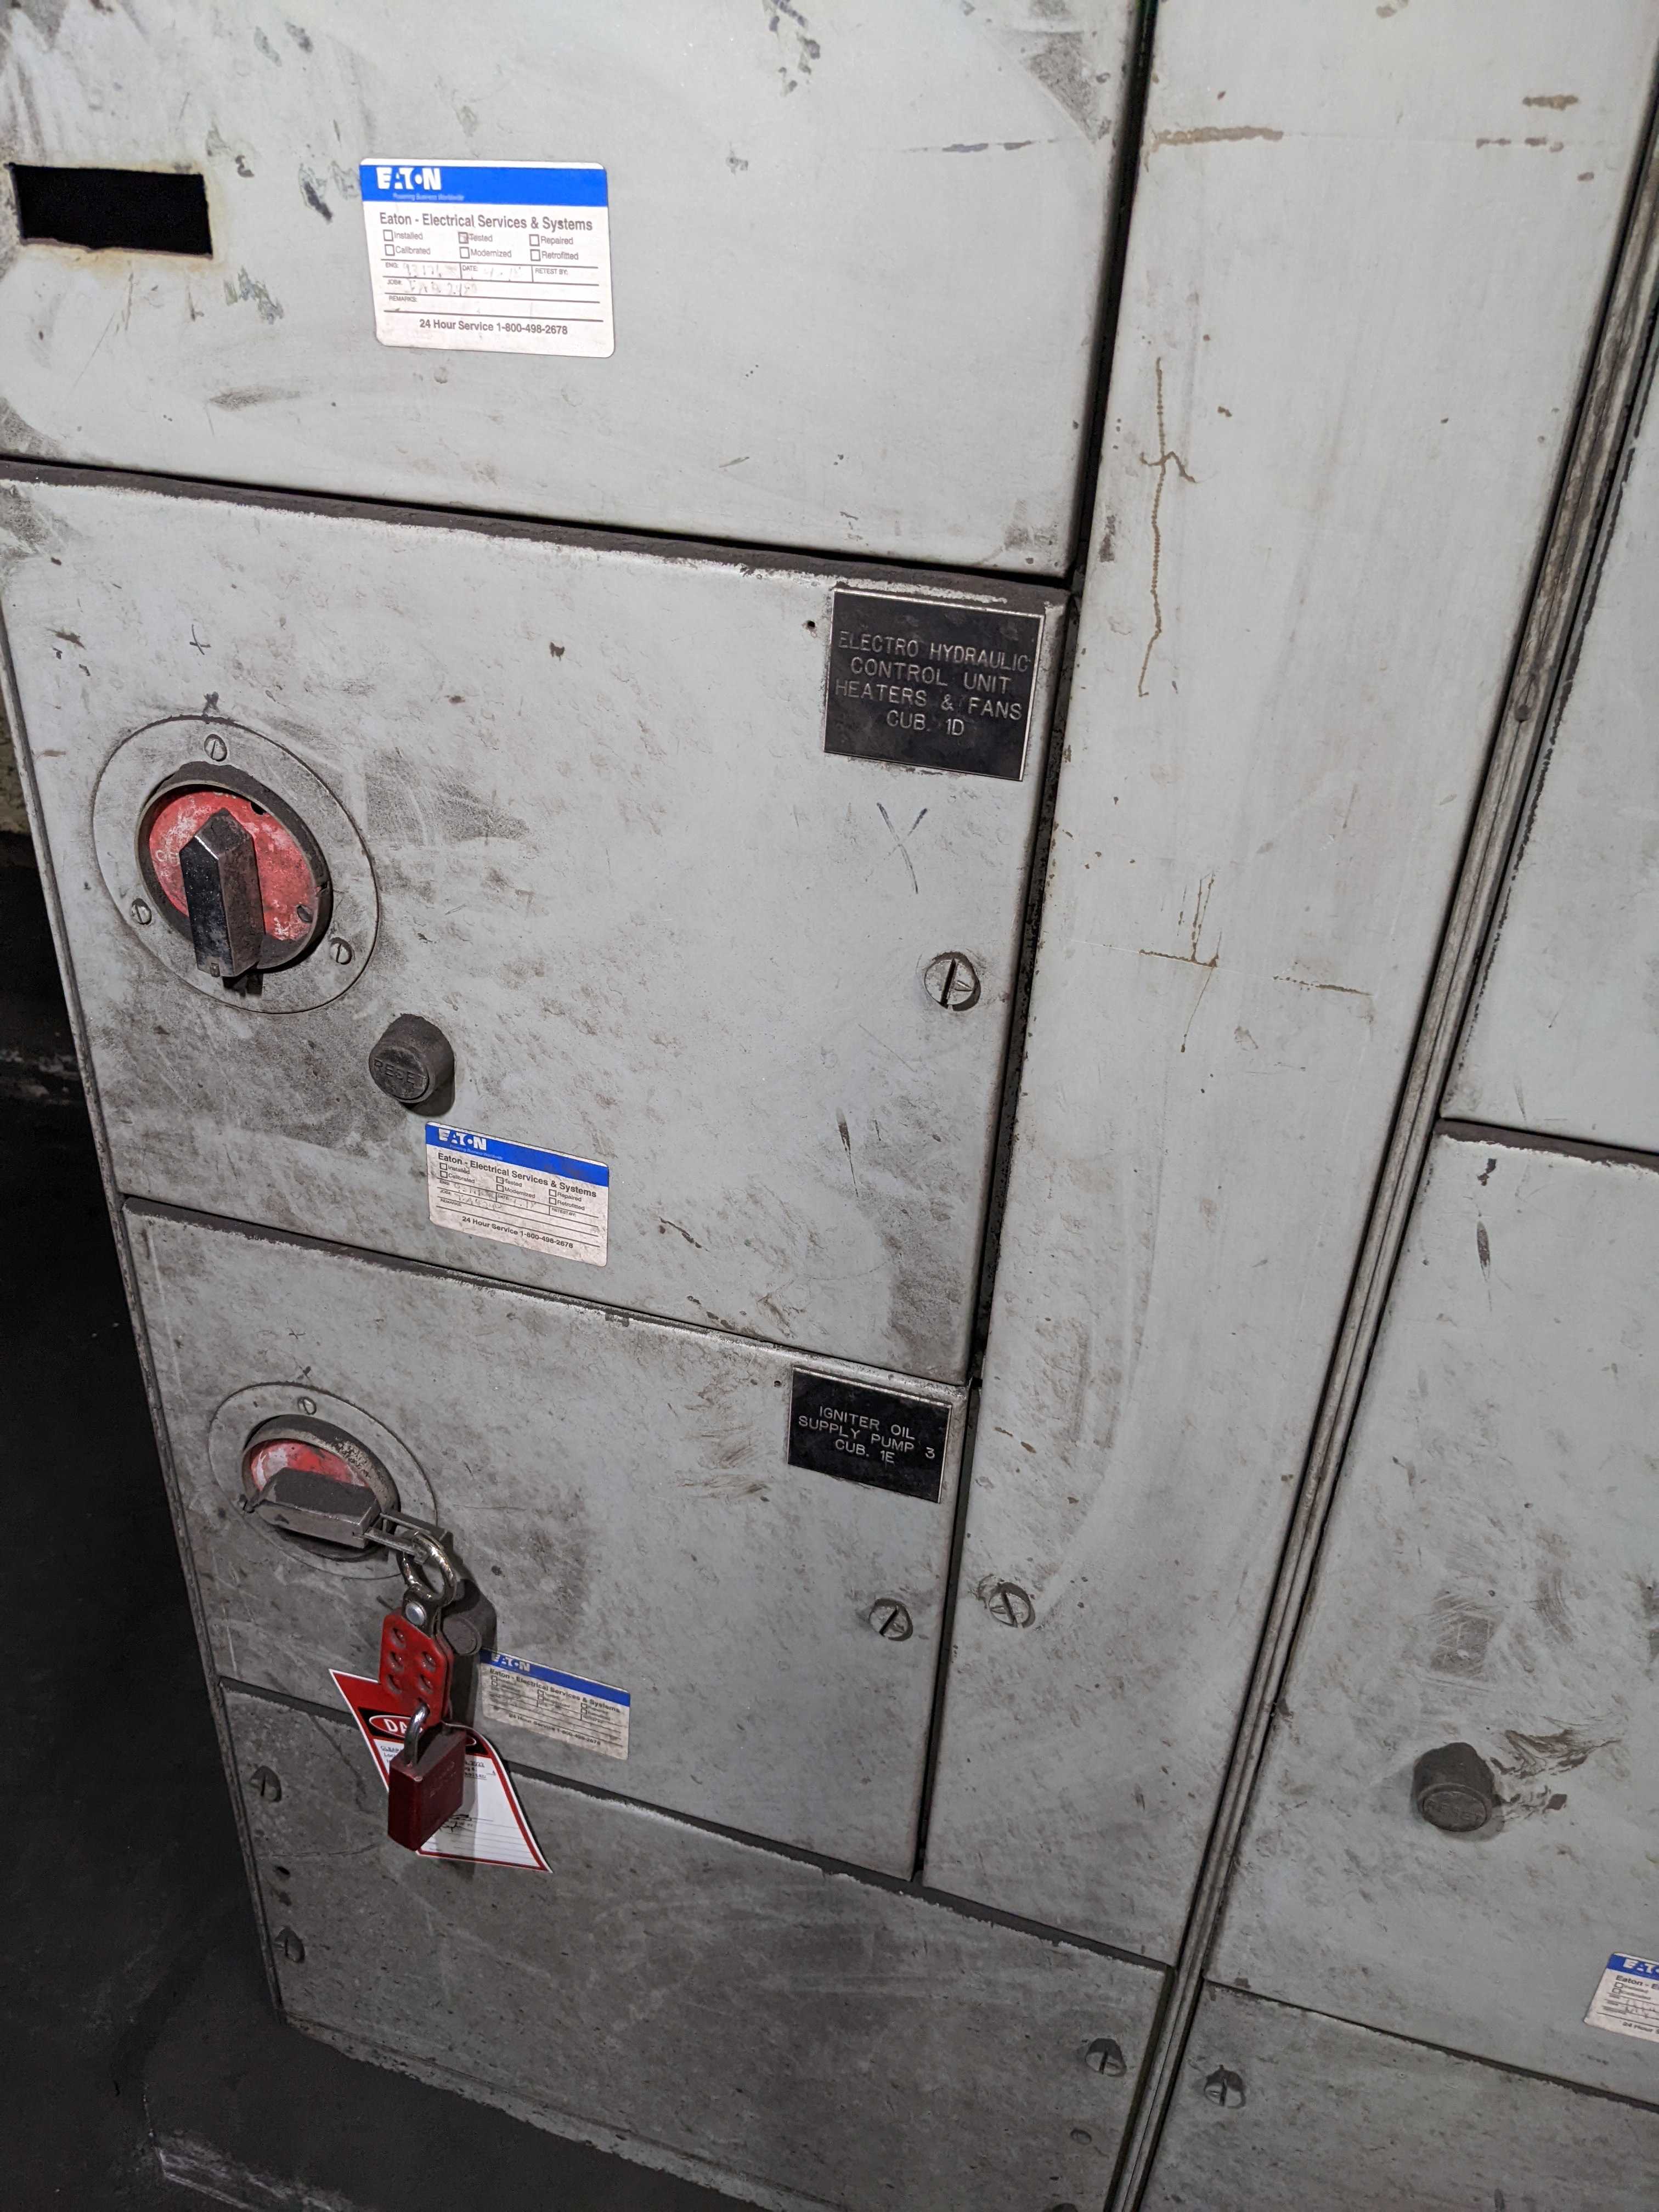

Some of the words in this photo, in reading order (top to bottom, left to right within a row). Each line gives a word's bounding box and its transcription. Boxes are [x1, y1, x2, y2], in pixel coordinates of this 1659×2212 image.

[376, 167, 442, 190] EATON
[380, 212, 412, 225] Eaton
[422, 213, 475, 228] Electrical
[478, 215, 527, 229] Services
[531, 216, 539, 229] &
[542, 217, 593, 232] Systems
[394, 231, 423, 240] Installed
[469, 233, 493, 242] Tested
[541, 235, 573, 247] Repaired
[395, 246, 431, 255] Calibrated
[470, 249, 512, 259] Modernized
[541, 250, 579, 261] Retrofitted
[420, 319, 431, 329] 24
[433, 320, 456, 330] Hour
[458, 320, 493, 331] Service
[496, 322, 568, 335] 1-800-498-2678
[839, 630, 919, 658] ELECTRO
[929, 642, 1029, 673] HYDRAULIC
[850, 657, 948, 686] CONTROL
[963, 672, 1012, 694] UNIT
[834, 679, 927, 707] HEATERS
[940, 694, 953, 712] &
[967, 697, 1023, 721] FANS
[946, 718, 964, 736] 1D
[438, 1127, 487, 1151] EATON
[438, 1153, 462, 1165] Eaton
[470, 1160, 509, 1176] Electrical
[511, 1170, 549, 1186] Services
[551, 1180, 557, 1188] &
[559, 1182, 597, 1198] Systems
[448, 1165, 470, 1175] Installed
[448, 1173, 475, 1184] Calibrated
[504, 1178, 522, 1187] Tested
[505, 1186, 535, 1199] Modernized
[557, 1191, 582, 1203] Repaired
[462, 1216, 471, 1224] 24
[472, 1218, 490, 1228] Hour
[492, 1223, 518, 1236] Service
[521, 1230, 574, 1249] 1-800-498-2678
[819, 1406, 880, 1431] IGNITER
[890, 1424, 916, 1440] OIL
[798, 1415, 861, 1440] SUPPLY
[871, 1433, 915, 1453] PUMP
[925, 1447, 935, 1459] 3
[835, 1439, 870, 1457] CUB.
[880, 1450, 895, 1464] 1E
[490, 1668, 510, 1679] Eaton
[516, 1676, 548, 1691] Electrical
[550, 1686, 580, 1701] Services
[589, 1699, 620, 1713] Systems
[1616, 1975, 1643, 1987] Eaton
